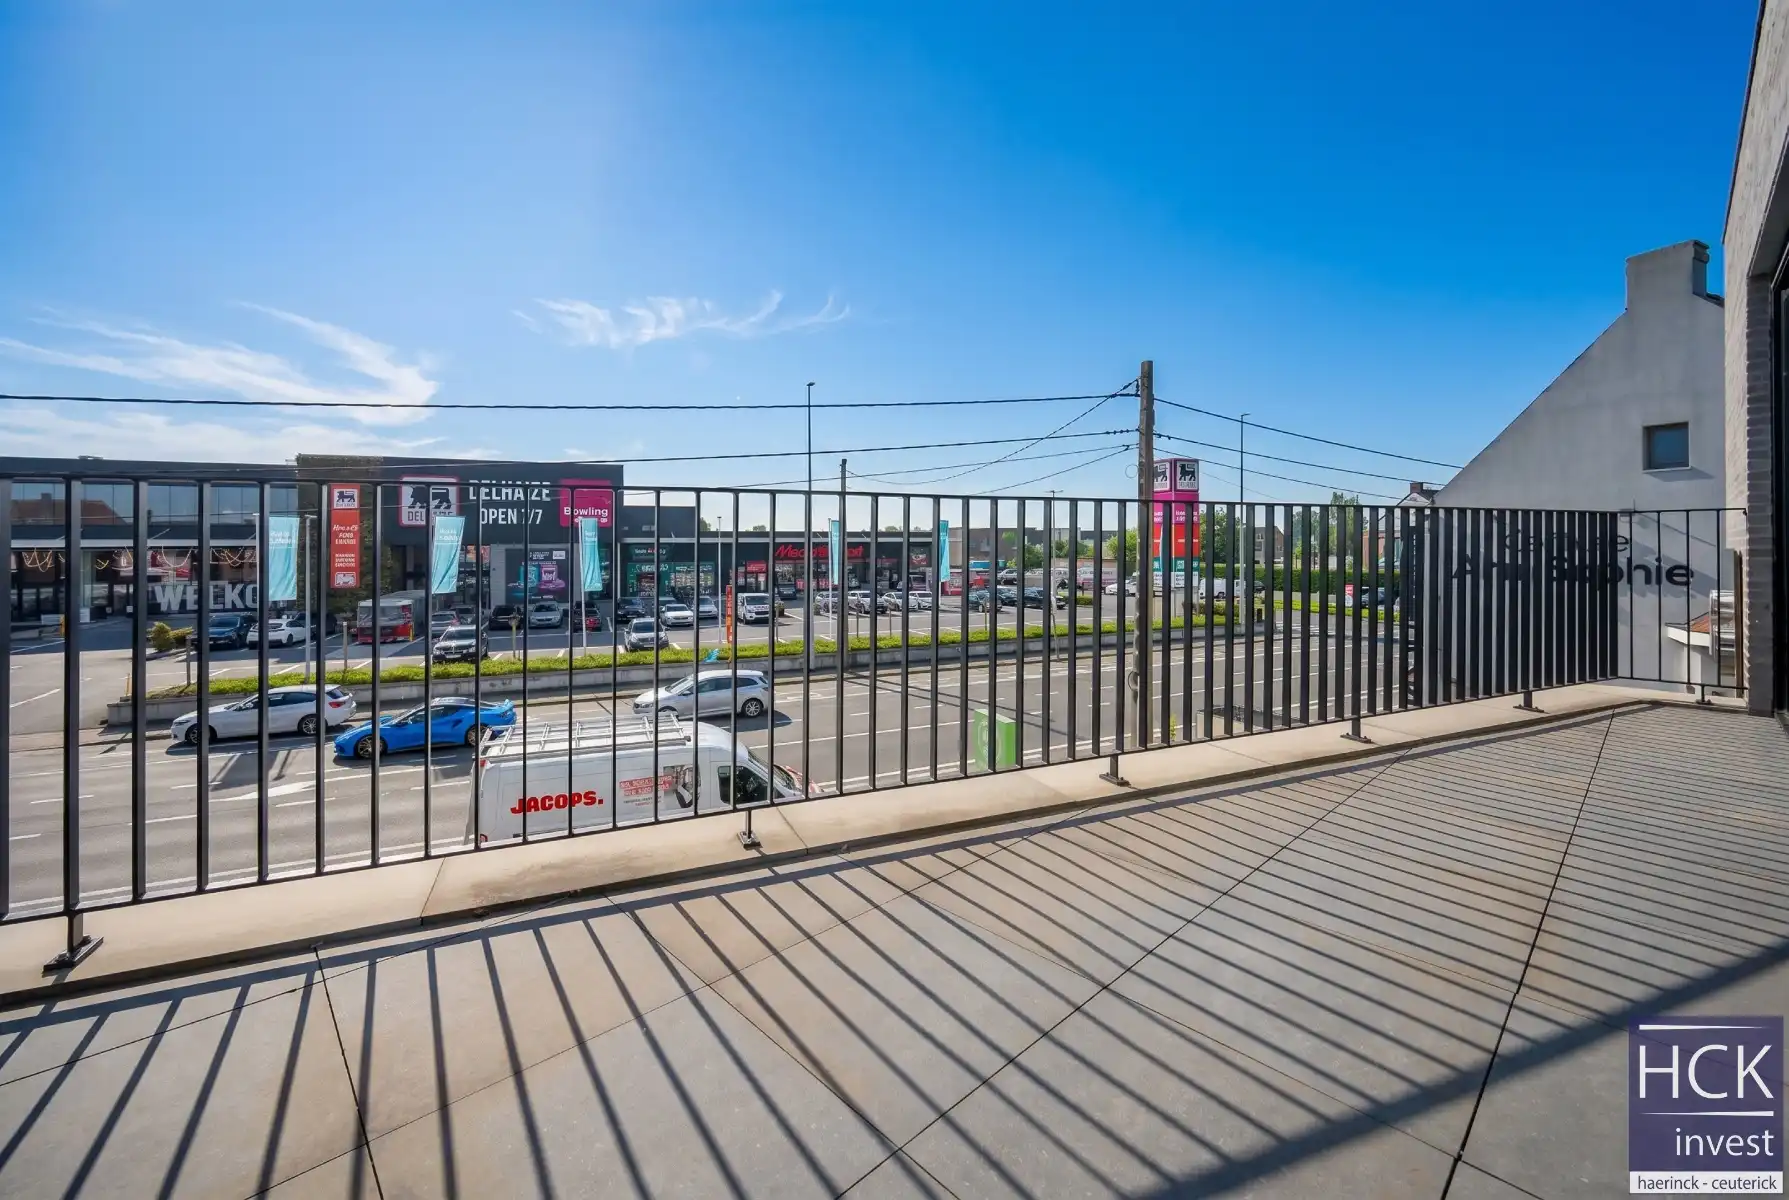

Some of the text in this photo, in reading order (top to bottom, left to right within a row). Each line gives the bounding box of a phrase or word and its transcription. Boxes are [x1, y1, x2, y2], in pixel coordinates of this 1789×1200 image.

[469, 480, 551, 501] DELHAZE
[480, 508, 517, 525] OPEN
[564, 507, 608, 517] Bowling
[510, 790, 604, 814] JACOPS.
